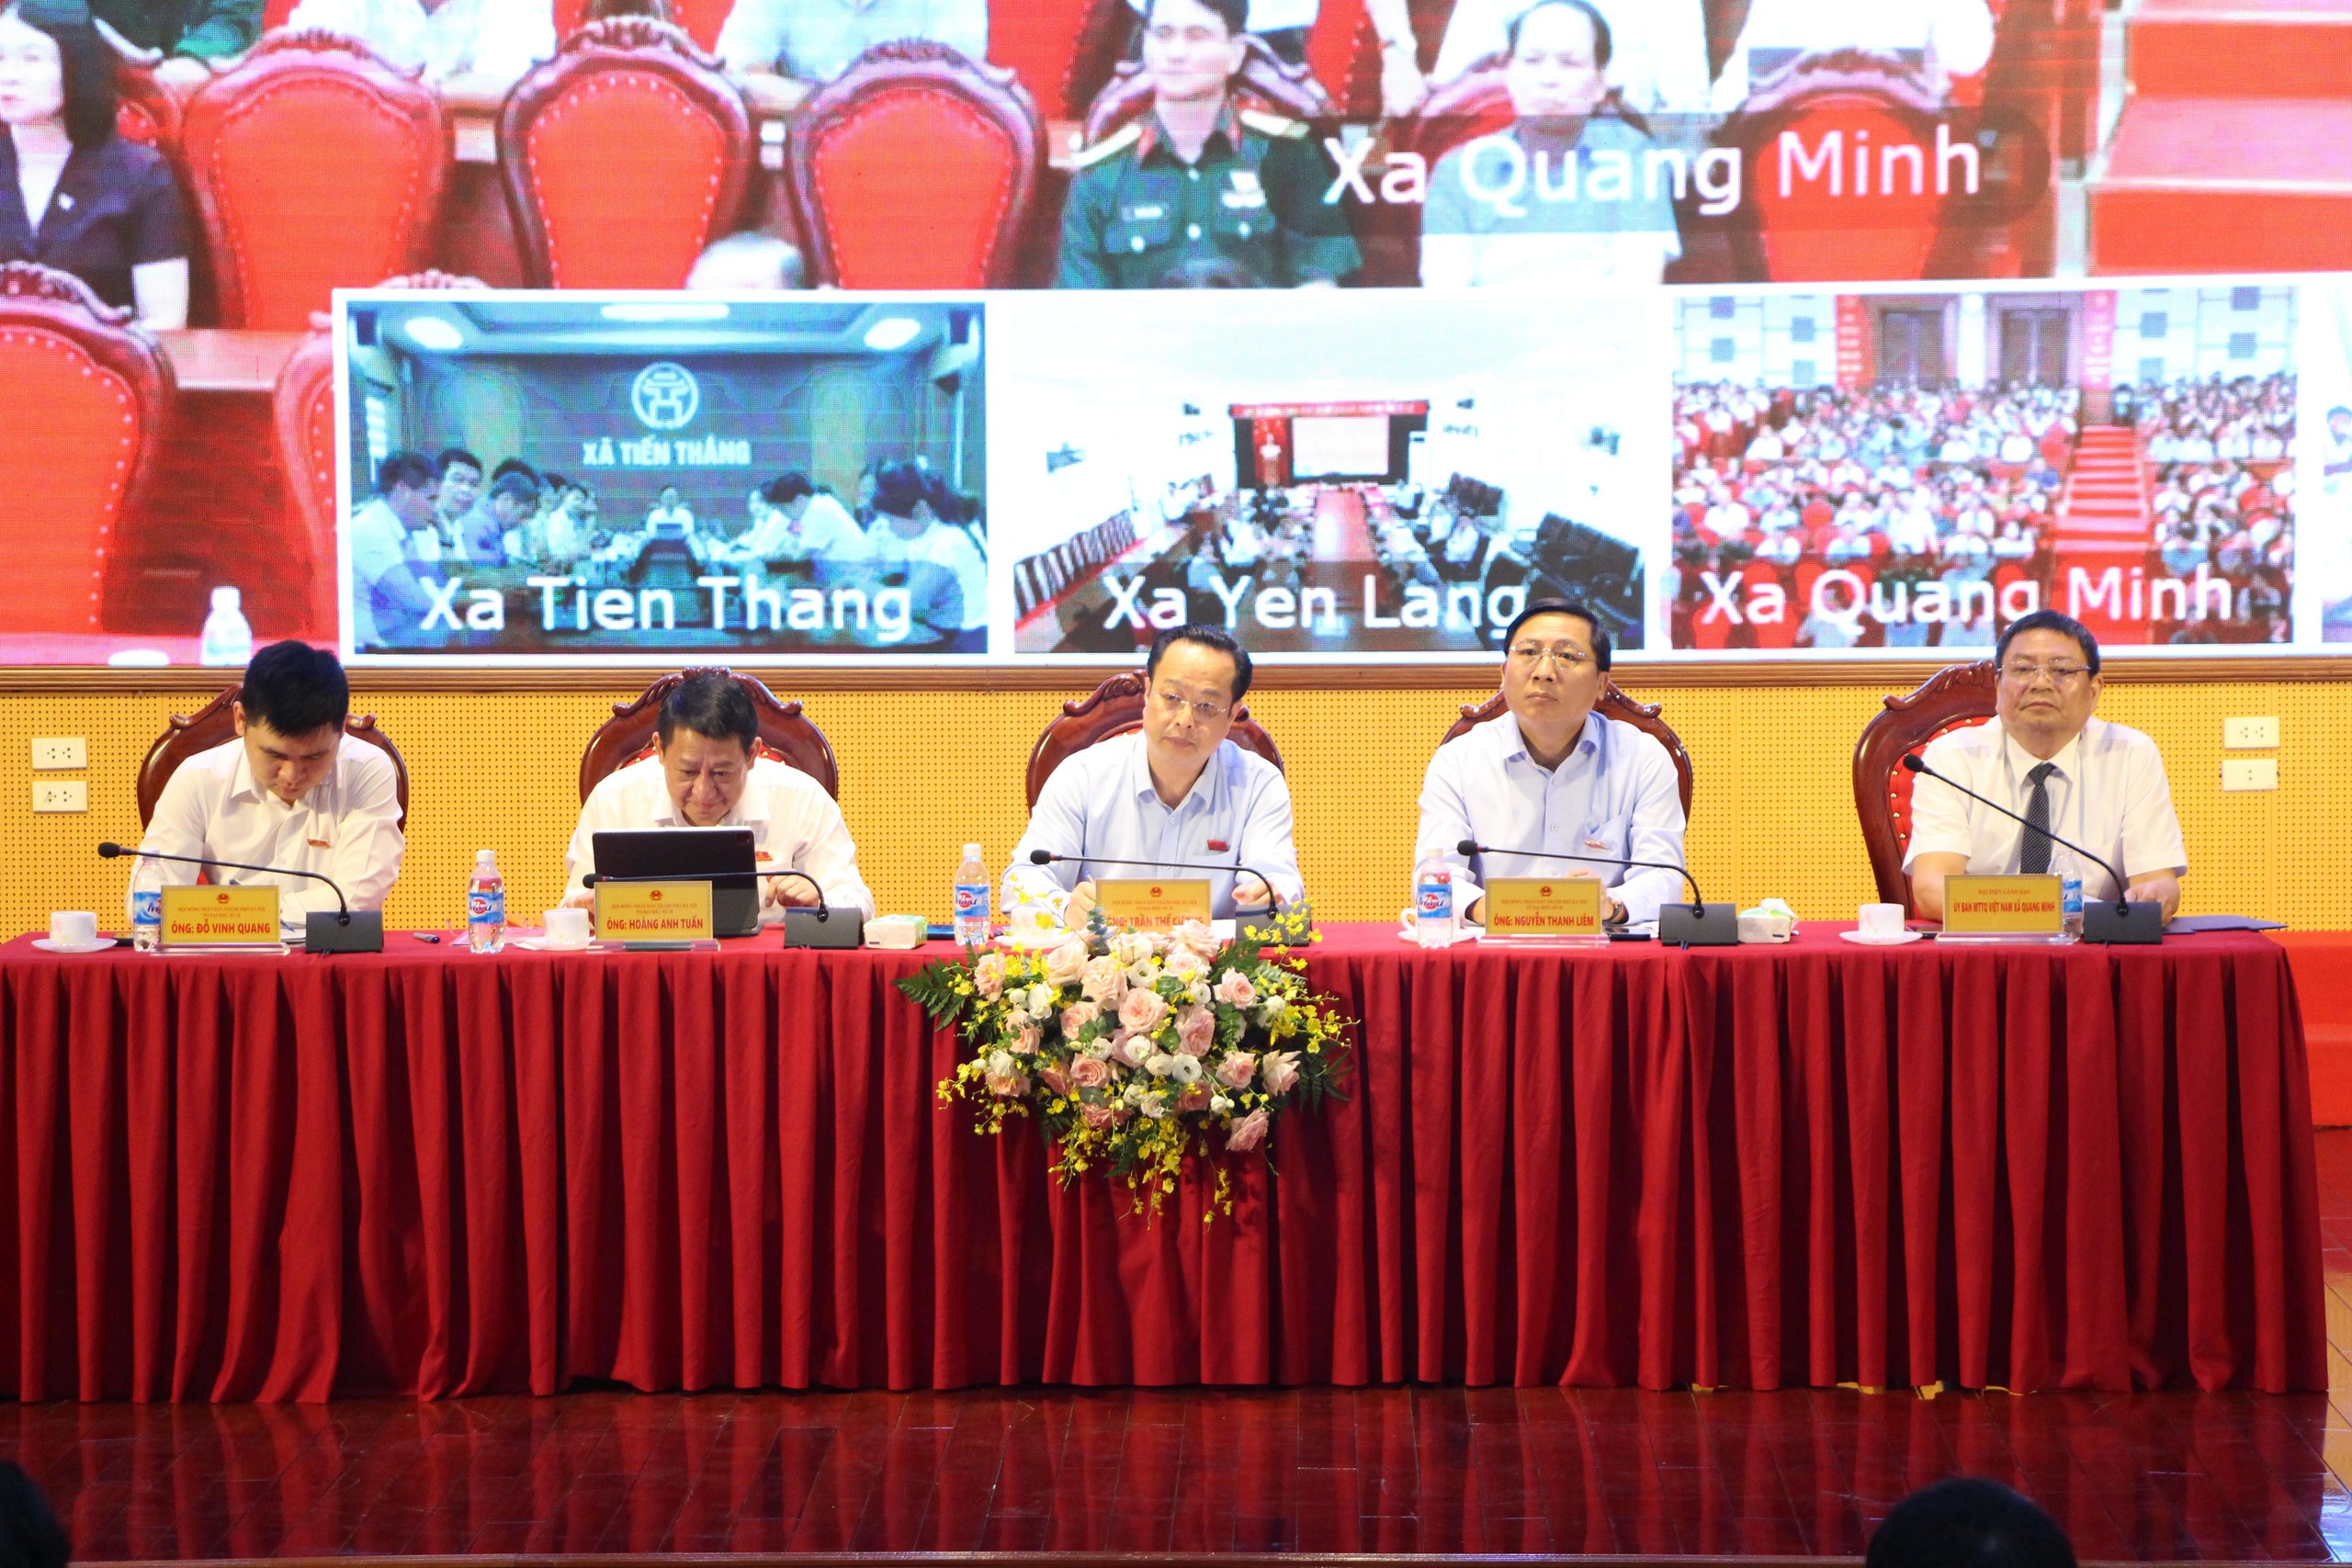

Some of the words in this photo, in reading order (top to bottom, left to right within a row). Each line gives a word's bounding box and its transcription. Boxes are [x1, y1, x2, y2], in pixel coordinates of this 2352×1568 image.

[1323, 137, 1426, 204] Xa
[1461, 135, 1741, 216] Quang
[1778, 125, 1981, 198] Minh
[419, 577, 504, 630] Xa
[526, 576, 675, 630] Tien
[697, 573, 911, 643] Thang
[1104, 574, 1187, 630] Xa
[1210, 575, 1338, 629] Yen
[1364, 574, 1527, 639] Lang
[1700, 570, 1784, 625] Xa
[1810, 569, 2039, 636] Quang
[2068, 562, 2232, 620] Minh
[171, 920, 194, 933] ÔNG:
[196, 919, 210, 933] ĐỖ
[212, 923, 235, 933] VINH
[237, 923, 270, 934] QUANG
[607, 917, 627, 930] ÔNG:
[629, 917, 658, 929] HOÀNG
[661, 919, 678, 928] ANH
[681, 915, 703, 928] TUẤN
[1494, 914, 1512, 926] ÔNG:
[1548, 916, 1574, 926] THANH
